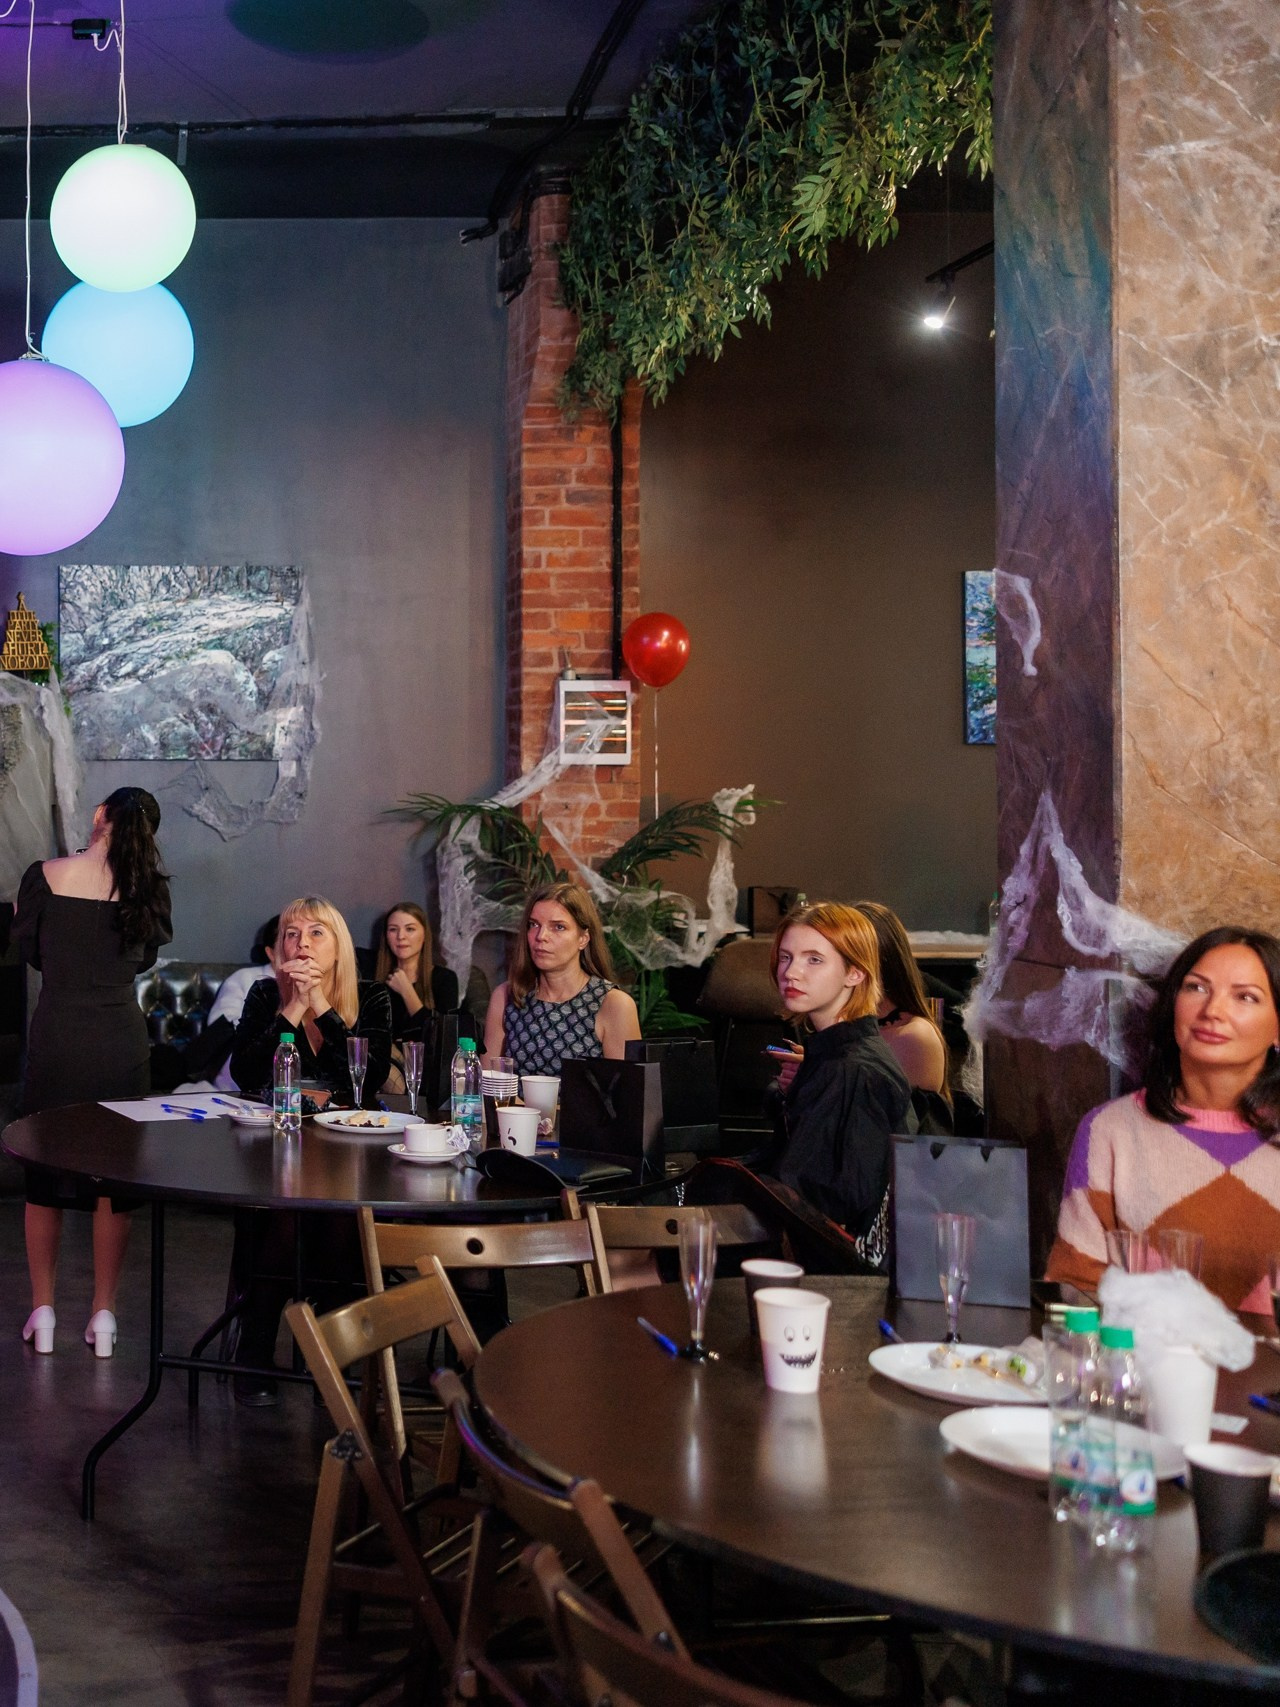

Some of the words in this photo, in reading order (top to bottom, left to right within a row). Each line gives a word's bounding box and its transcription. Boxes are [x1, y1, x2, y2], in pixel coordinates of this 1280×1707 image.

[7, 619, 40, 631] PARTY
[6, 629, 43, 643] NEVER
[8, 642, 43, 656] HURT
